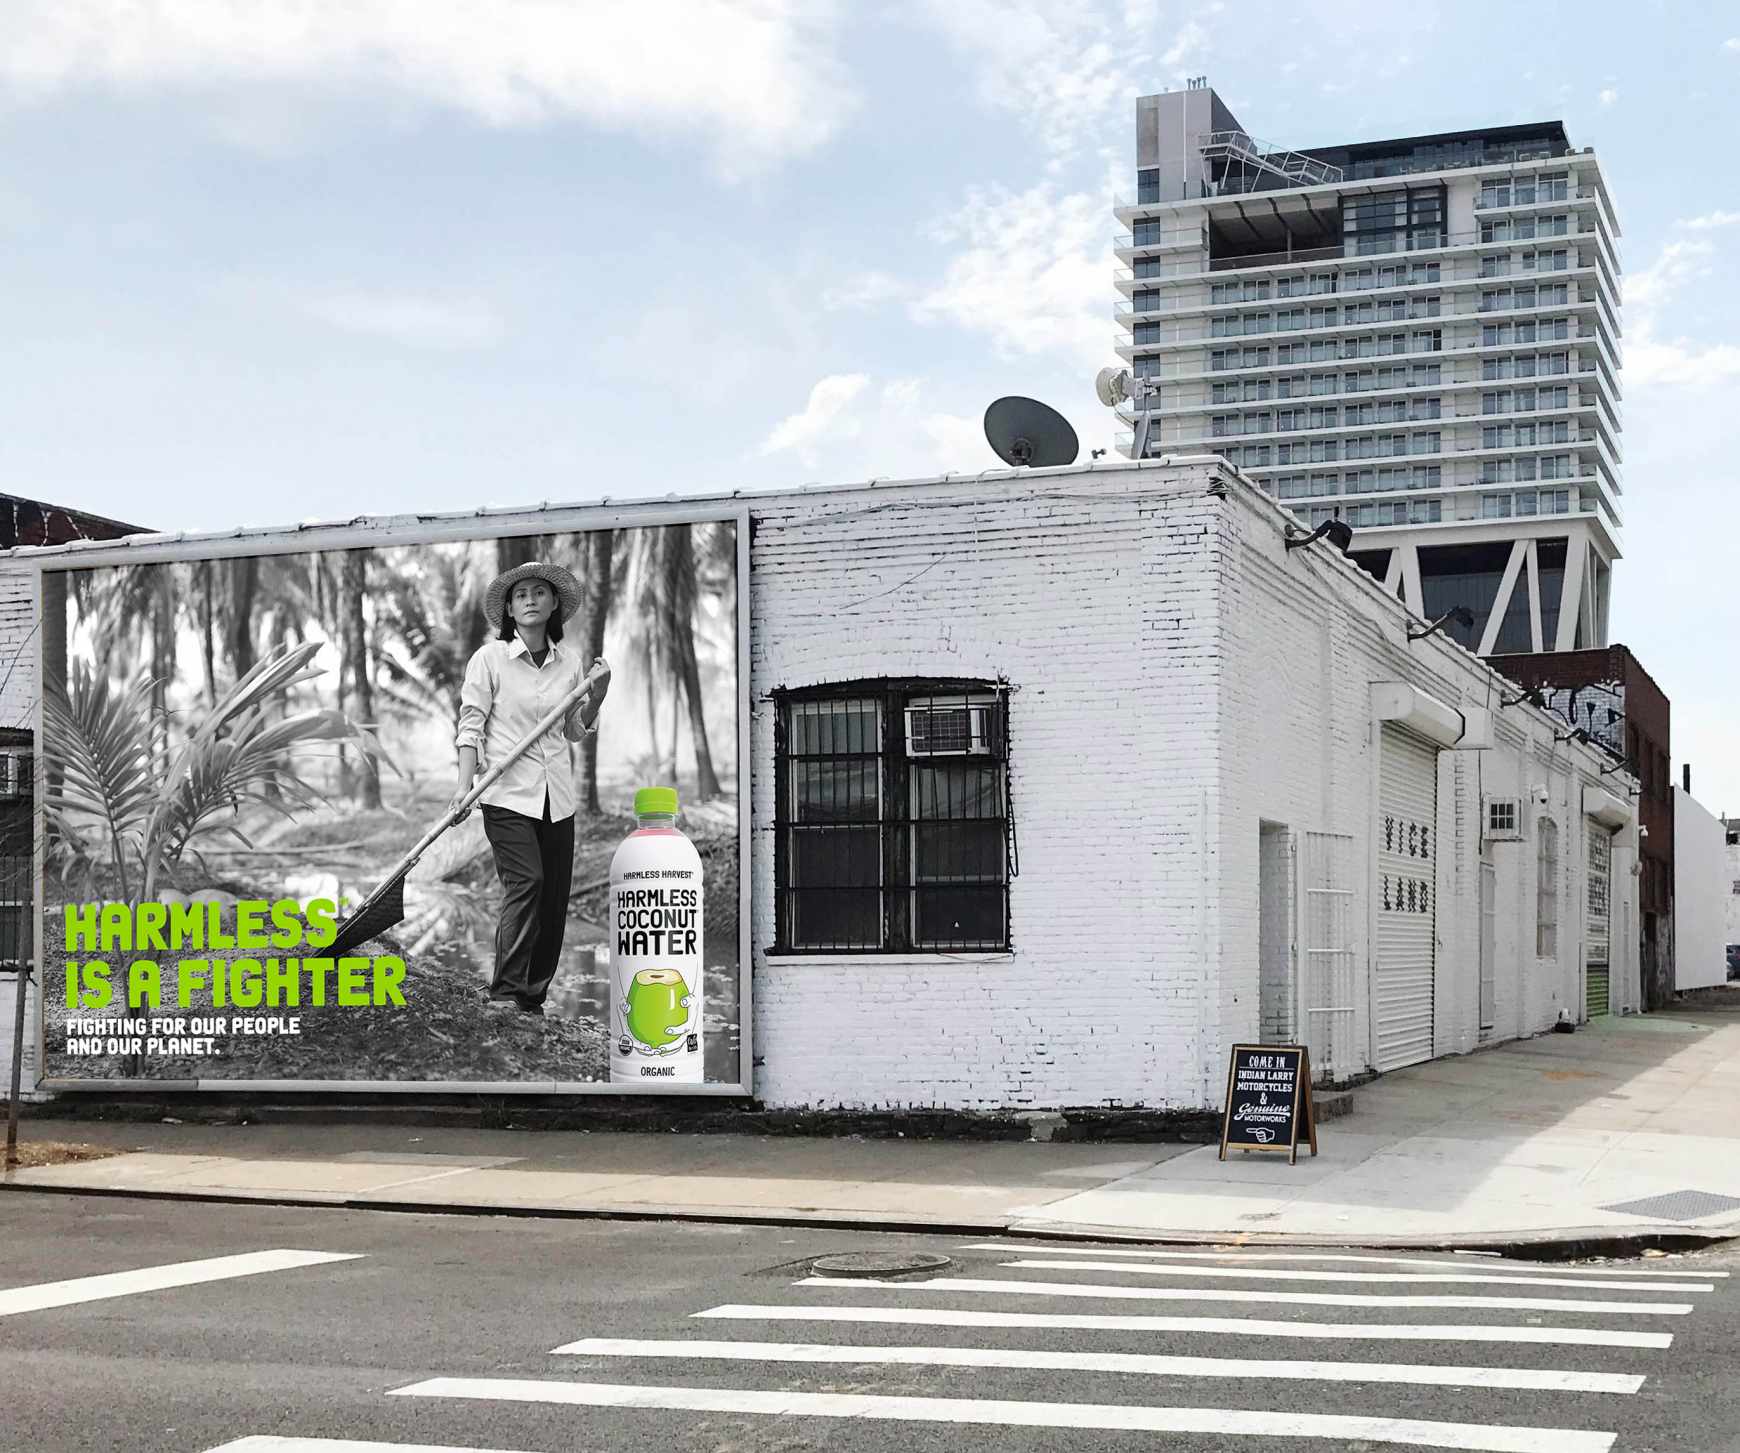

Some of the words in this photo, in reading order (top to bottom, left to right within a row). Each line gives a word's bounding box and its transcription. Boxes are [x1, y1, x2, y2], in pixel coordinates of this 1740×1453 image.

[624, 871, 660, 880] HARMLESS
[661, 870, 692, 880] HARVEST
[617, 889, 697, 908] HARMLESS
[65, 898, 337, 951] HARMLESS
[617, 908, 697, 929] COCONUT
[618, 930, 697, 956] WATER
[66, 961, 113, 1009] IS
[129, 960, 160, 1009] A
[178, 956, 407, 1008] FIGHTER
[66, 1018, 146, 1035] FIGHTING
[152, 1018, 186, 1034] FOR
[190, 1018, 227, 1034] OUR
[232, 1017, 300, 1034] PEOPLE
[67, 1038, 102, 1055] AND
[107, 1038, 142, 1054] OUR
[147, 1037, 221, 1055] PLANET.
[1249, 1056, 1273, 1068] COME
[1276, 1057, 1286, 1069] IN
[641, 1066, 675, 1076] ORGANIC
[1238, 1070, 1266, 1080] INDIAN
[1267, 1071, 1294, 1080] LARRY
[1237, 1082, 1293, 1092] MOTORCYCLES
[1260, 1092, 1267, 1104] &
[1244, 1115, 1286, 1123] MOTORWORKS
